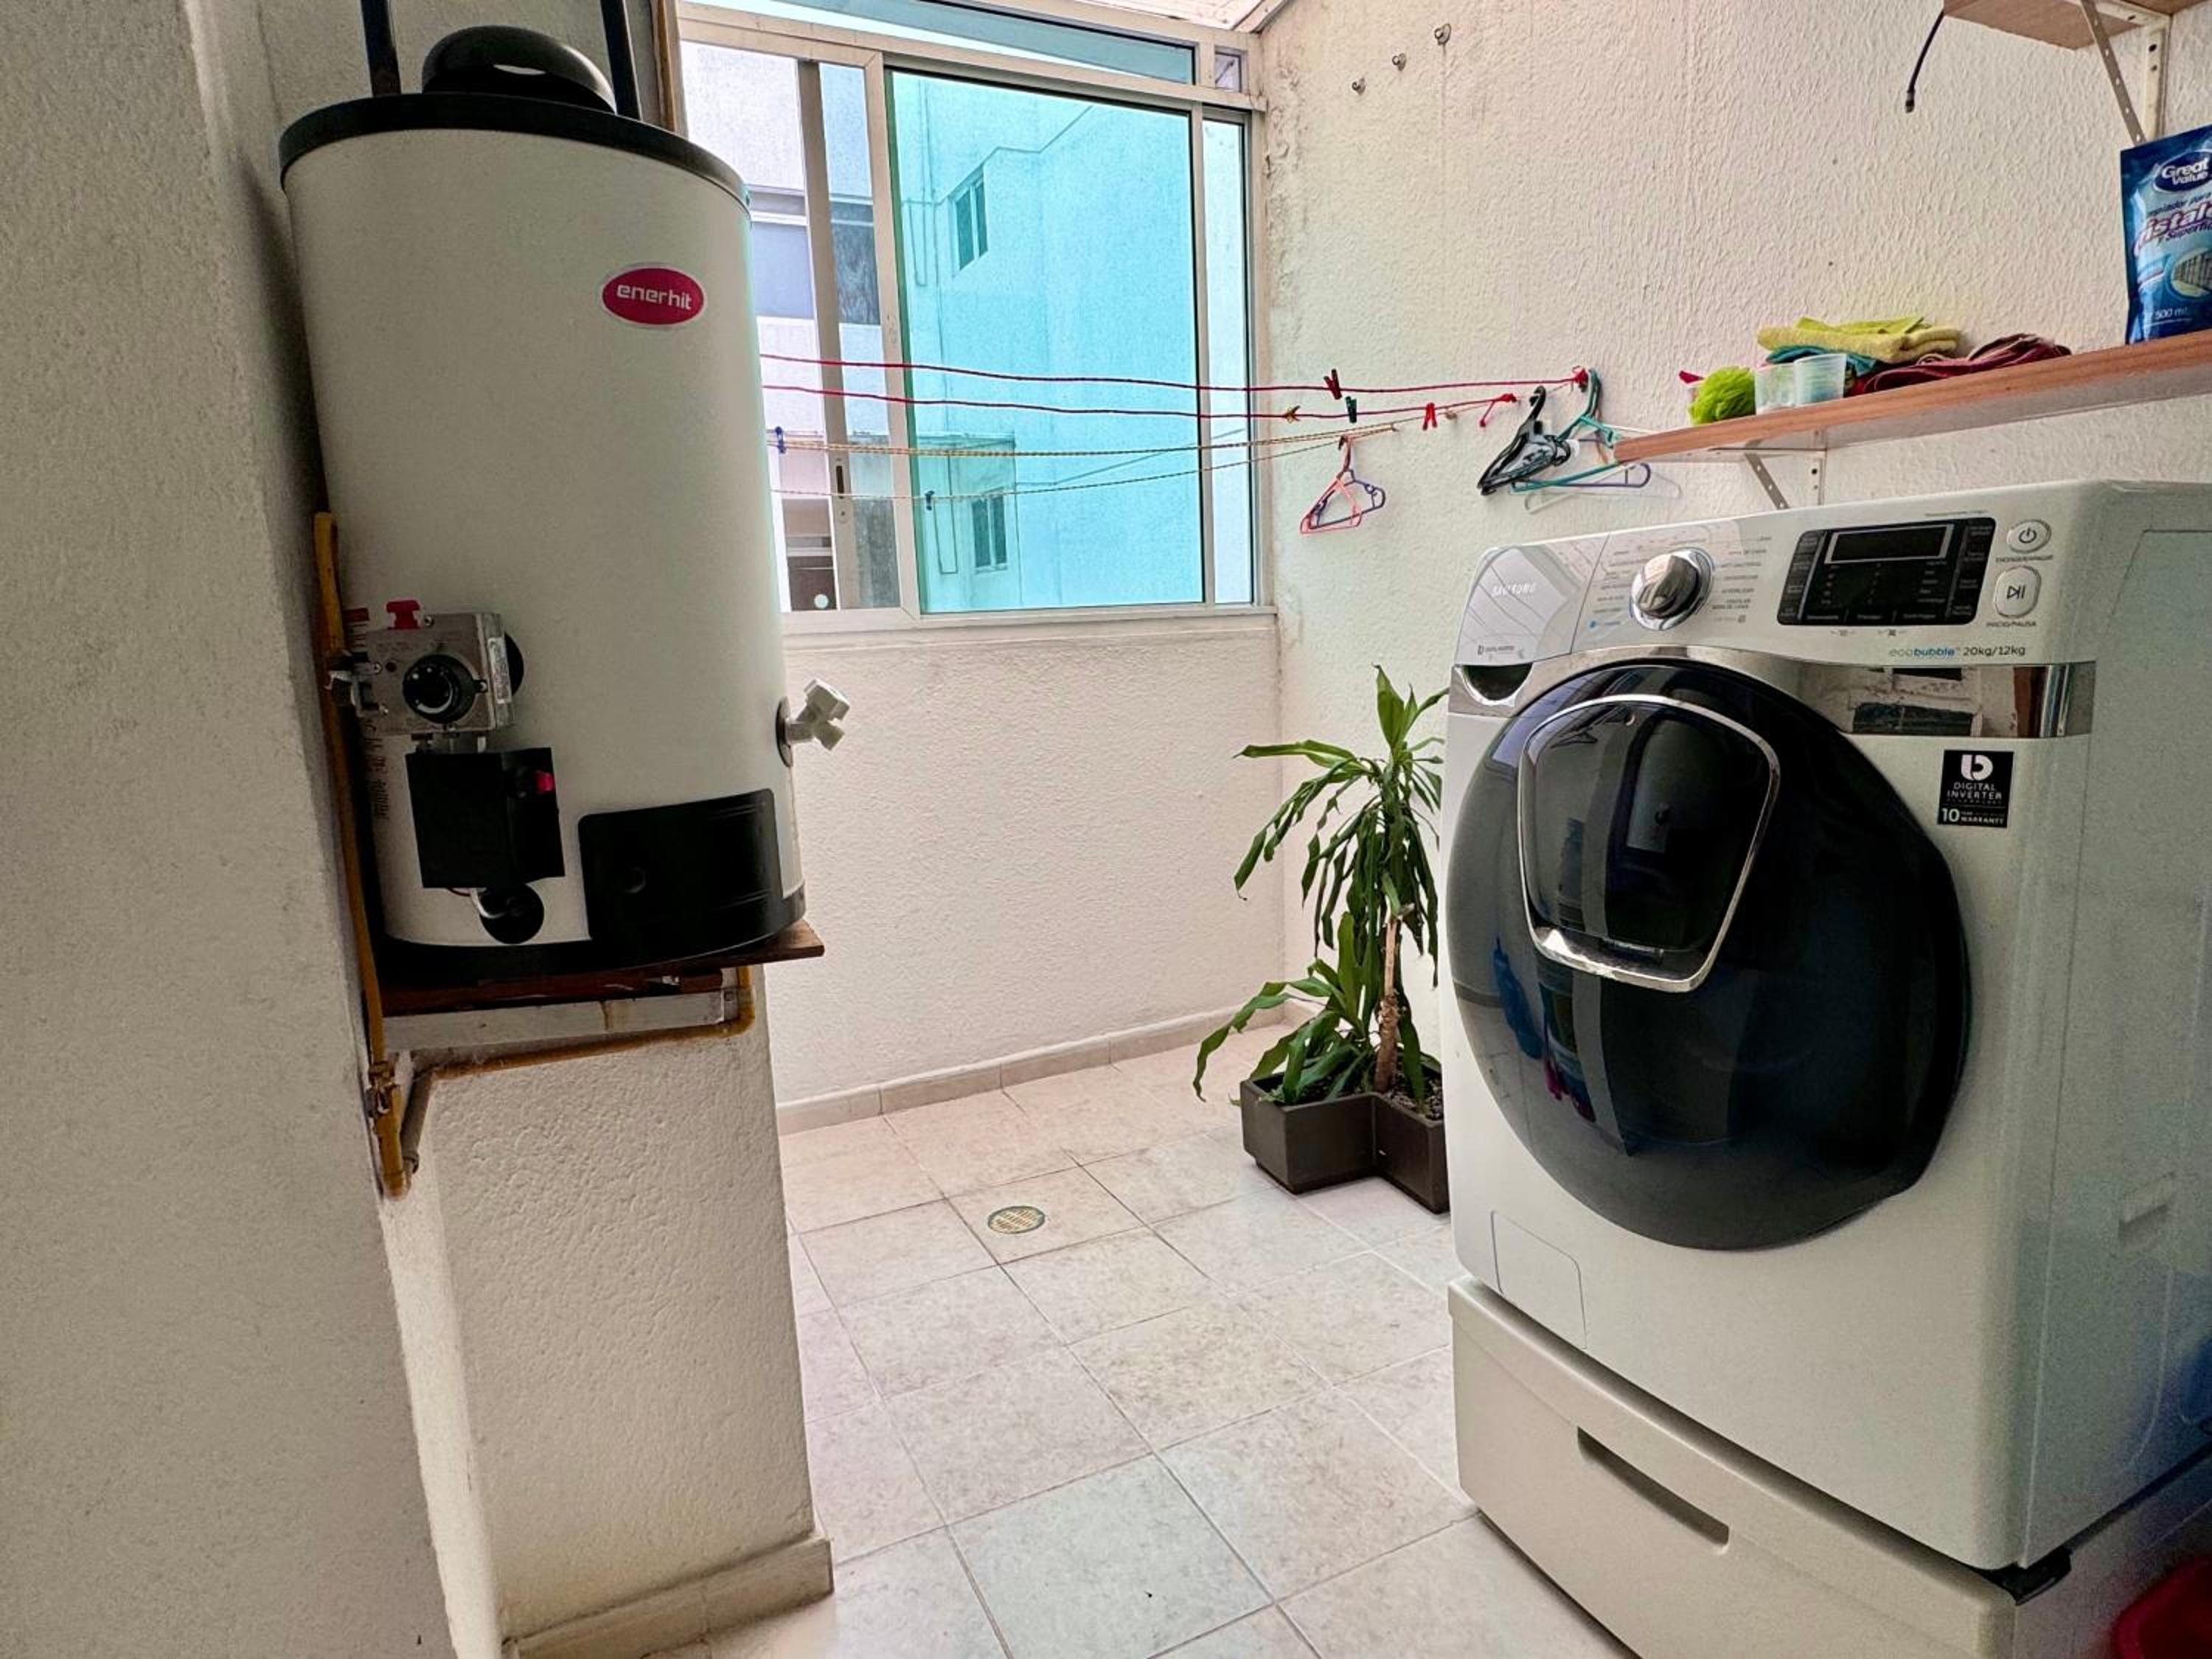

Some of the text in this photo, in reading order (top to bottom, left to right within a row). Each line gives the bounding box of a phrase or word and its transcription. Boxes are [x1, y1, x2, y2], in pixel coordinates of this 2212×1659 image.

[2161, 157, 2210, 179] Great
[2171, 171, 2209, 186] Value
[616, 284, 692, 310] enerhit
[1963, 645, 2026, 657] 20kg/12kg
[1953, 782, 1995, 791] DIGITAL
[1947, 790, 2002, 800] INVERTER
[1941, 808, 1960, 822] 10
